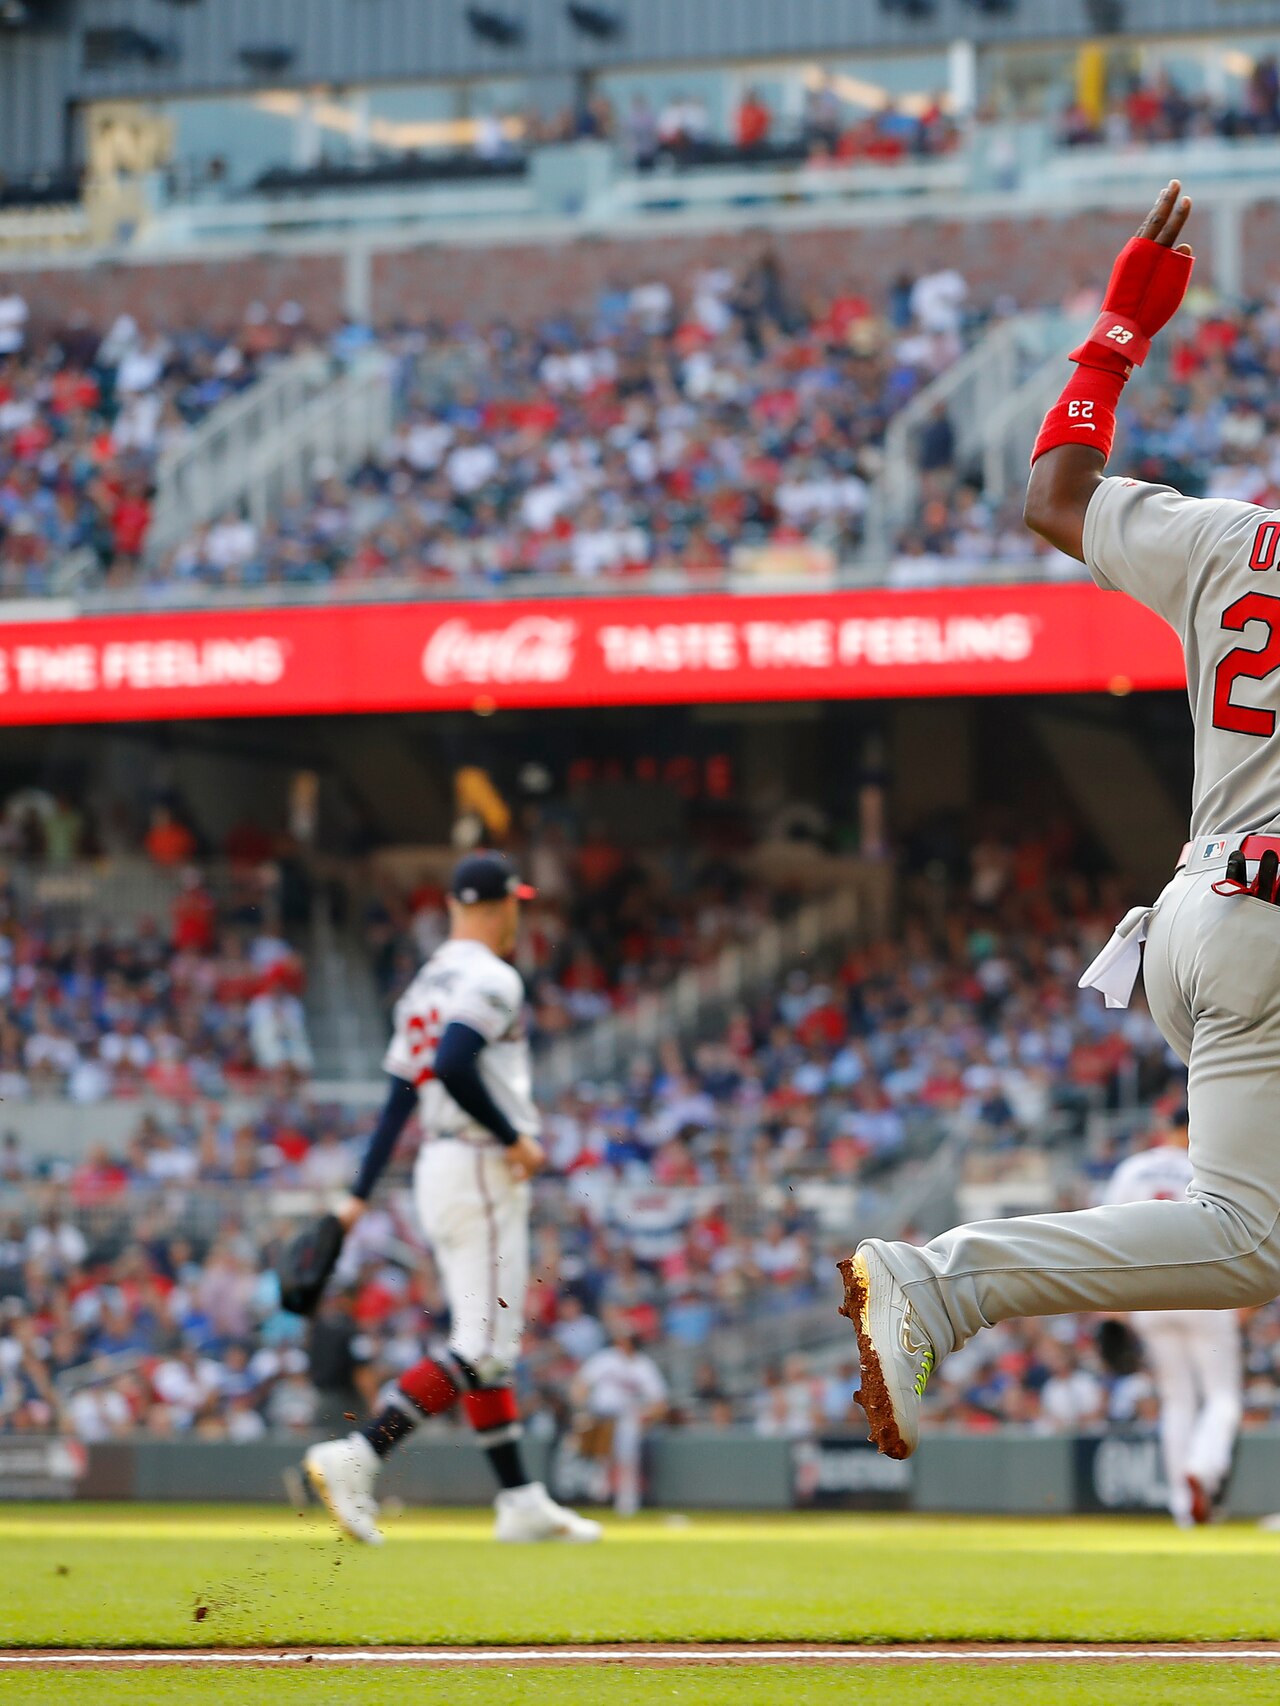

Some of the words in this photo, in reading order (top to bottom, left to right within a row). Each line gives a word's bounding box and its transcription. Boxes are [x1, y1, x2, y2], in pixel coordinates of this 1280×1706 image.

[1106, 325, 1133, 344] 23
[1068, 401, 1094, 418] 23
[599, 621, 739, 673] TASTE
[744, 618, 832, 668] THE
[838, 612, 1033, 665] FEELING
[15, 643, 97, 693] THE
[103, 636, 285, 690] FEELING
